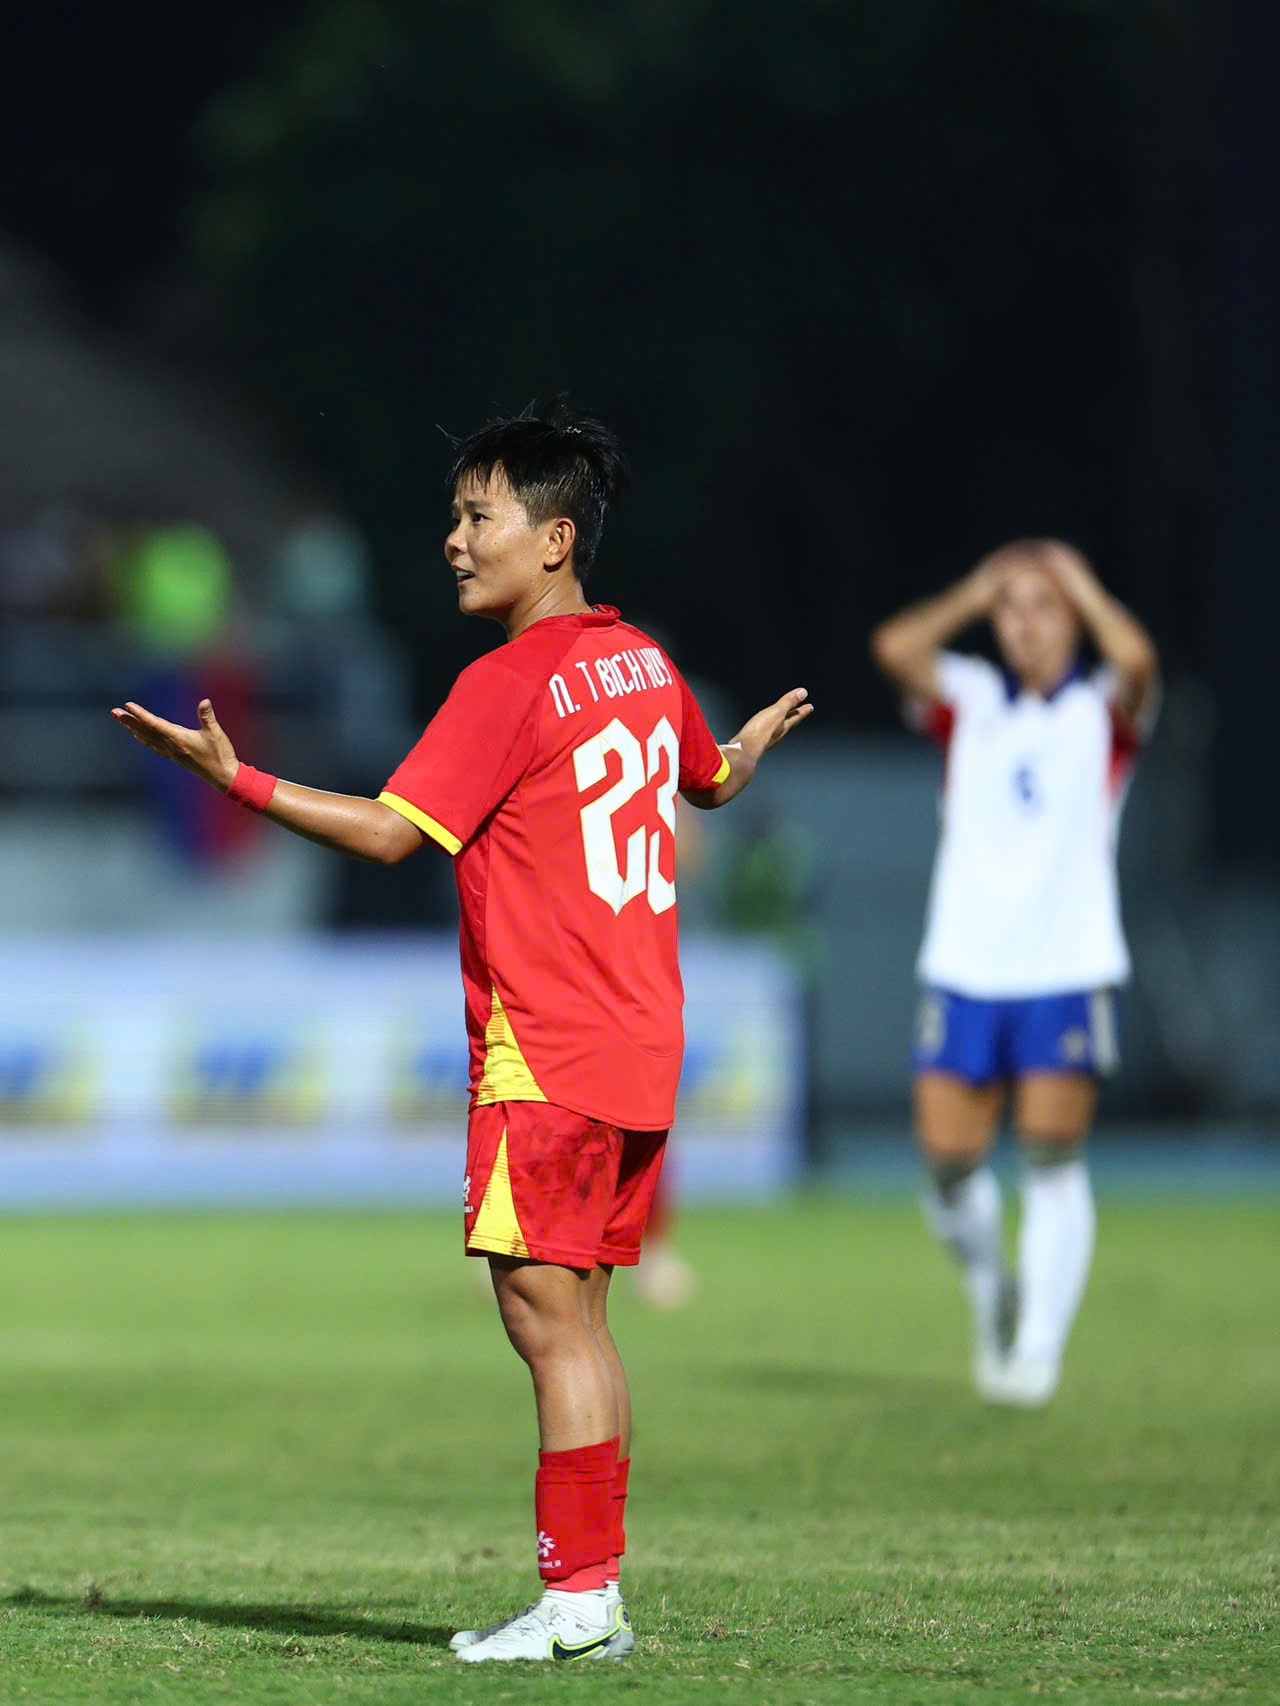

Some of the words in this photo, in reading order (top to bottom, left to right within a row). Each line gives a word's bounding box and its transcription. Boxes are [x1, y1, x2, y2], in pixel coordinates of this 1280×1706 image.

[575, 661, 599, 703] T
[594, 649, 648, 698] BICH
[573, 715, 680, 916] 23
